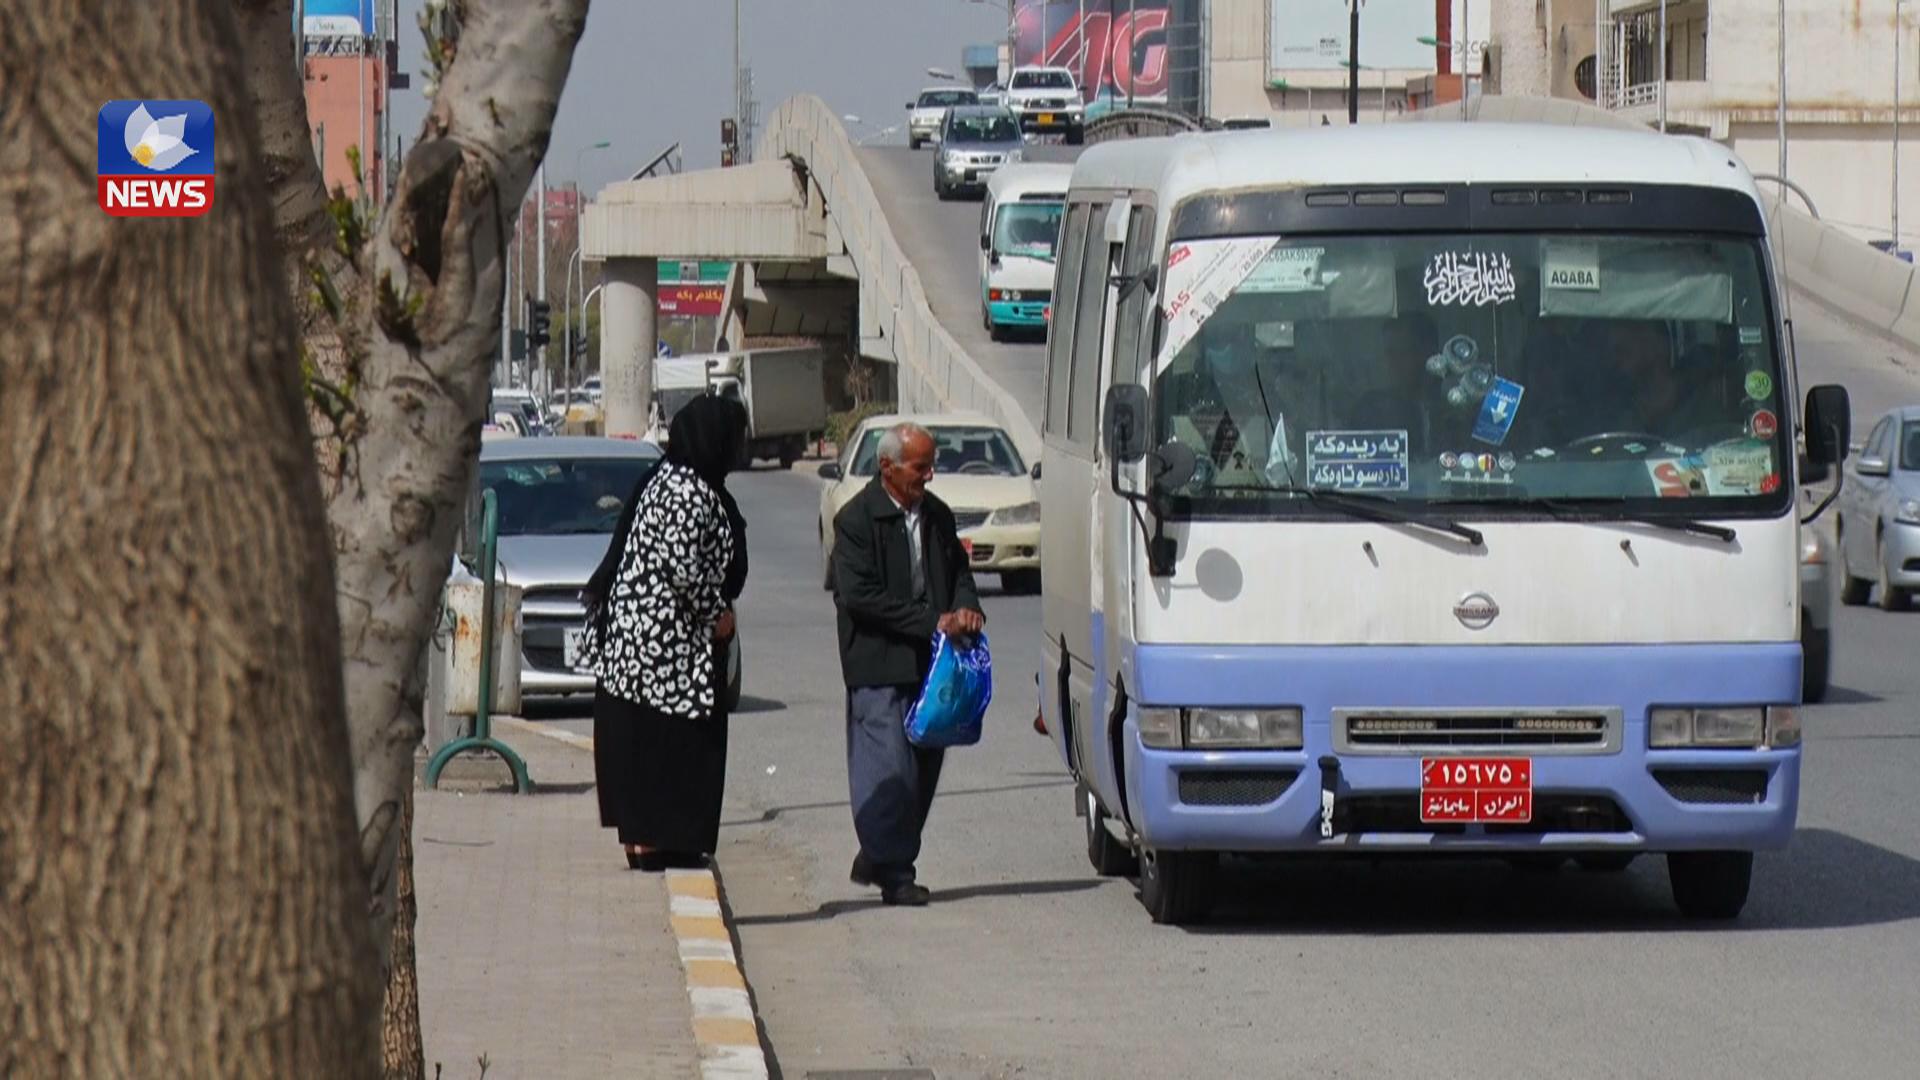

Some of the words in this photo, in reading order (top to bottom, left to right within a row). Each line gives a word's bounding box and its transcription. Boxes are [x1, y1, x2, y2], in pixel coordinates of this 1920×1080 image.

[1551, 270, 1594, 286] AQABA
[1442, 763, 1512, 784] ١٥٦٧٥
[1484, 795, 1523, 816] العراق
